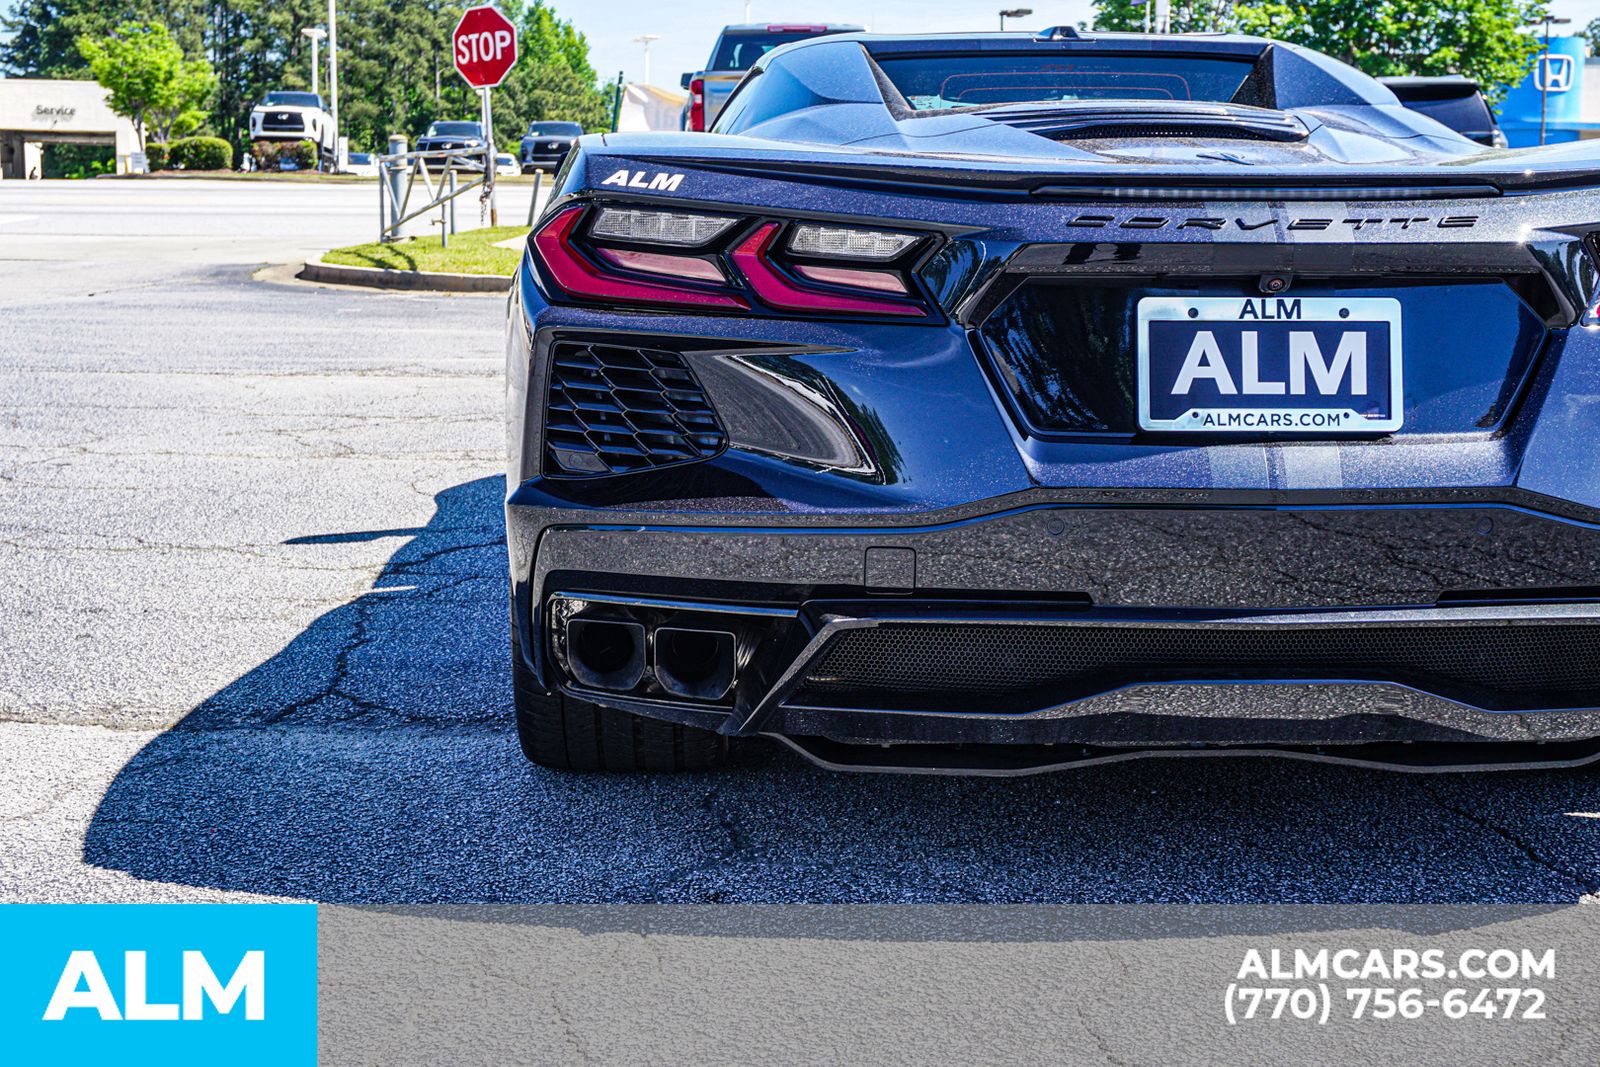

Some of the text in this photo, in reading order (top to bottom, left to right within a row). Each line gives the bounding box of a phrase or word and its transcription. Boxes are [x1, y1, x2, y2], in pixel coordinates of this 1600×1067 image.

[457, 30, 511, 65] STOP
[36, 105, 76, 116] Service
[601, 170, 685, 192] ALM
[1066, 215, 1479, 231] CORVETTE
[1239, 299, 1302, 320] ALM
[1171, 331, 1368, 396] ALM
[1203, 413, 1341, 427] ALMCARS.COM
